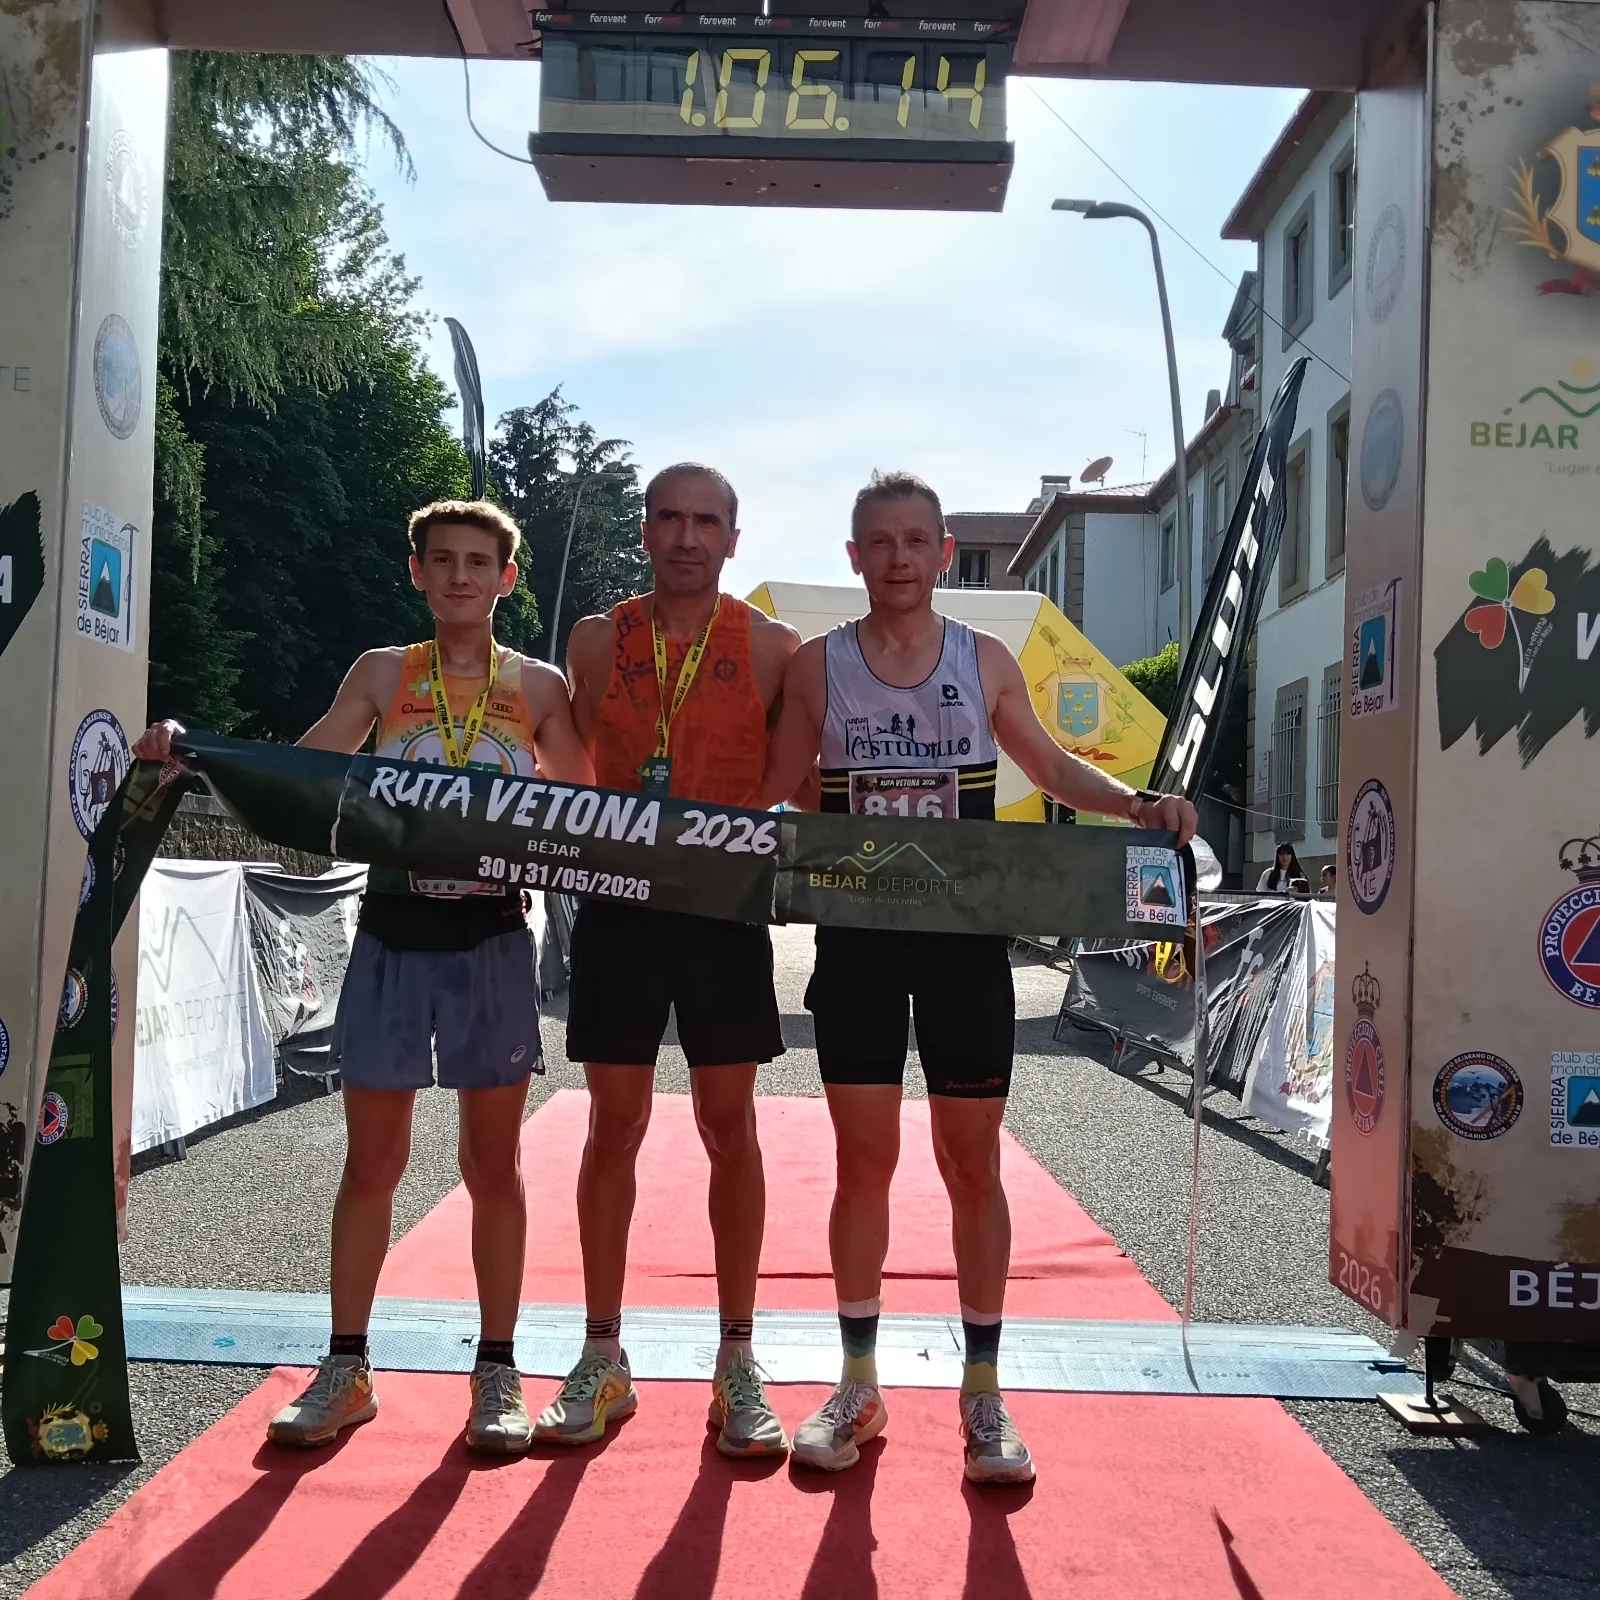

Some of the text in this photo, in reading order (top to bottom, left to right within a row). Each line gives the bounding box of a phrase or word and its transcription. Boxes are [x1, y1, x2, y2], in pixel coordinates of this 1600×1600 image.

[1470, 407, 1579, 449] BÉJAR
[78, 536, 91, 610] SIERRA
[77, 613, 120, 644] de Béjar
[1351, 626, 1361, 696] SIERRA
[1351, 692, 1385, 716] de Béjar
[71, 793, 88, 836] GRUPO
[114, 723, 124, 739] DE
[895, 777, 920, 787] VETONA
[369, 766, 778, 855] RUTA VETONA 2026
[864, 794, 943, 819] 816
[527, 839, 581, 859] BÉJAR
[1126, 846, 1168, 857] club de
[478, 855, 505, 879] 30
[508, 862, 524, 883] y
[809, 865, 965, 895] BÉJAR DEPORTE
[1127, 865, 1138, 907] SIERRA
[1127, 908, 1178, 924] de Béjar
[1438, 1061, 1455, 1080] GRUPO
[1551, 1052, 1581, 1063] club
[1550, 1076, 1565, 1129] SIERRA
[1440, 1114, 1487, 1139] ANIVERSARIO
[1550, 1130, 1573, 1144] de
[1339, 1252, 1381, 1309] 2026
